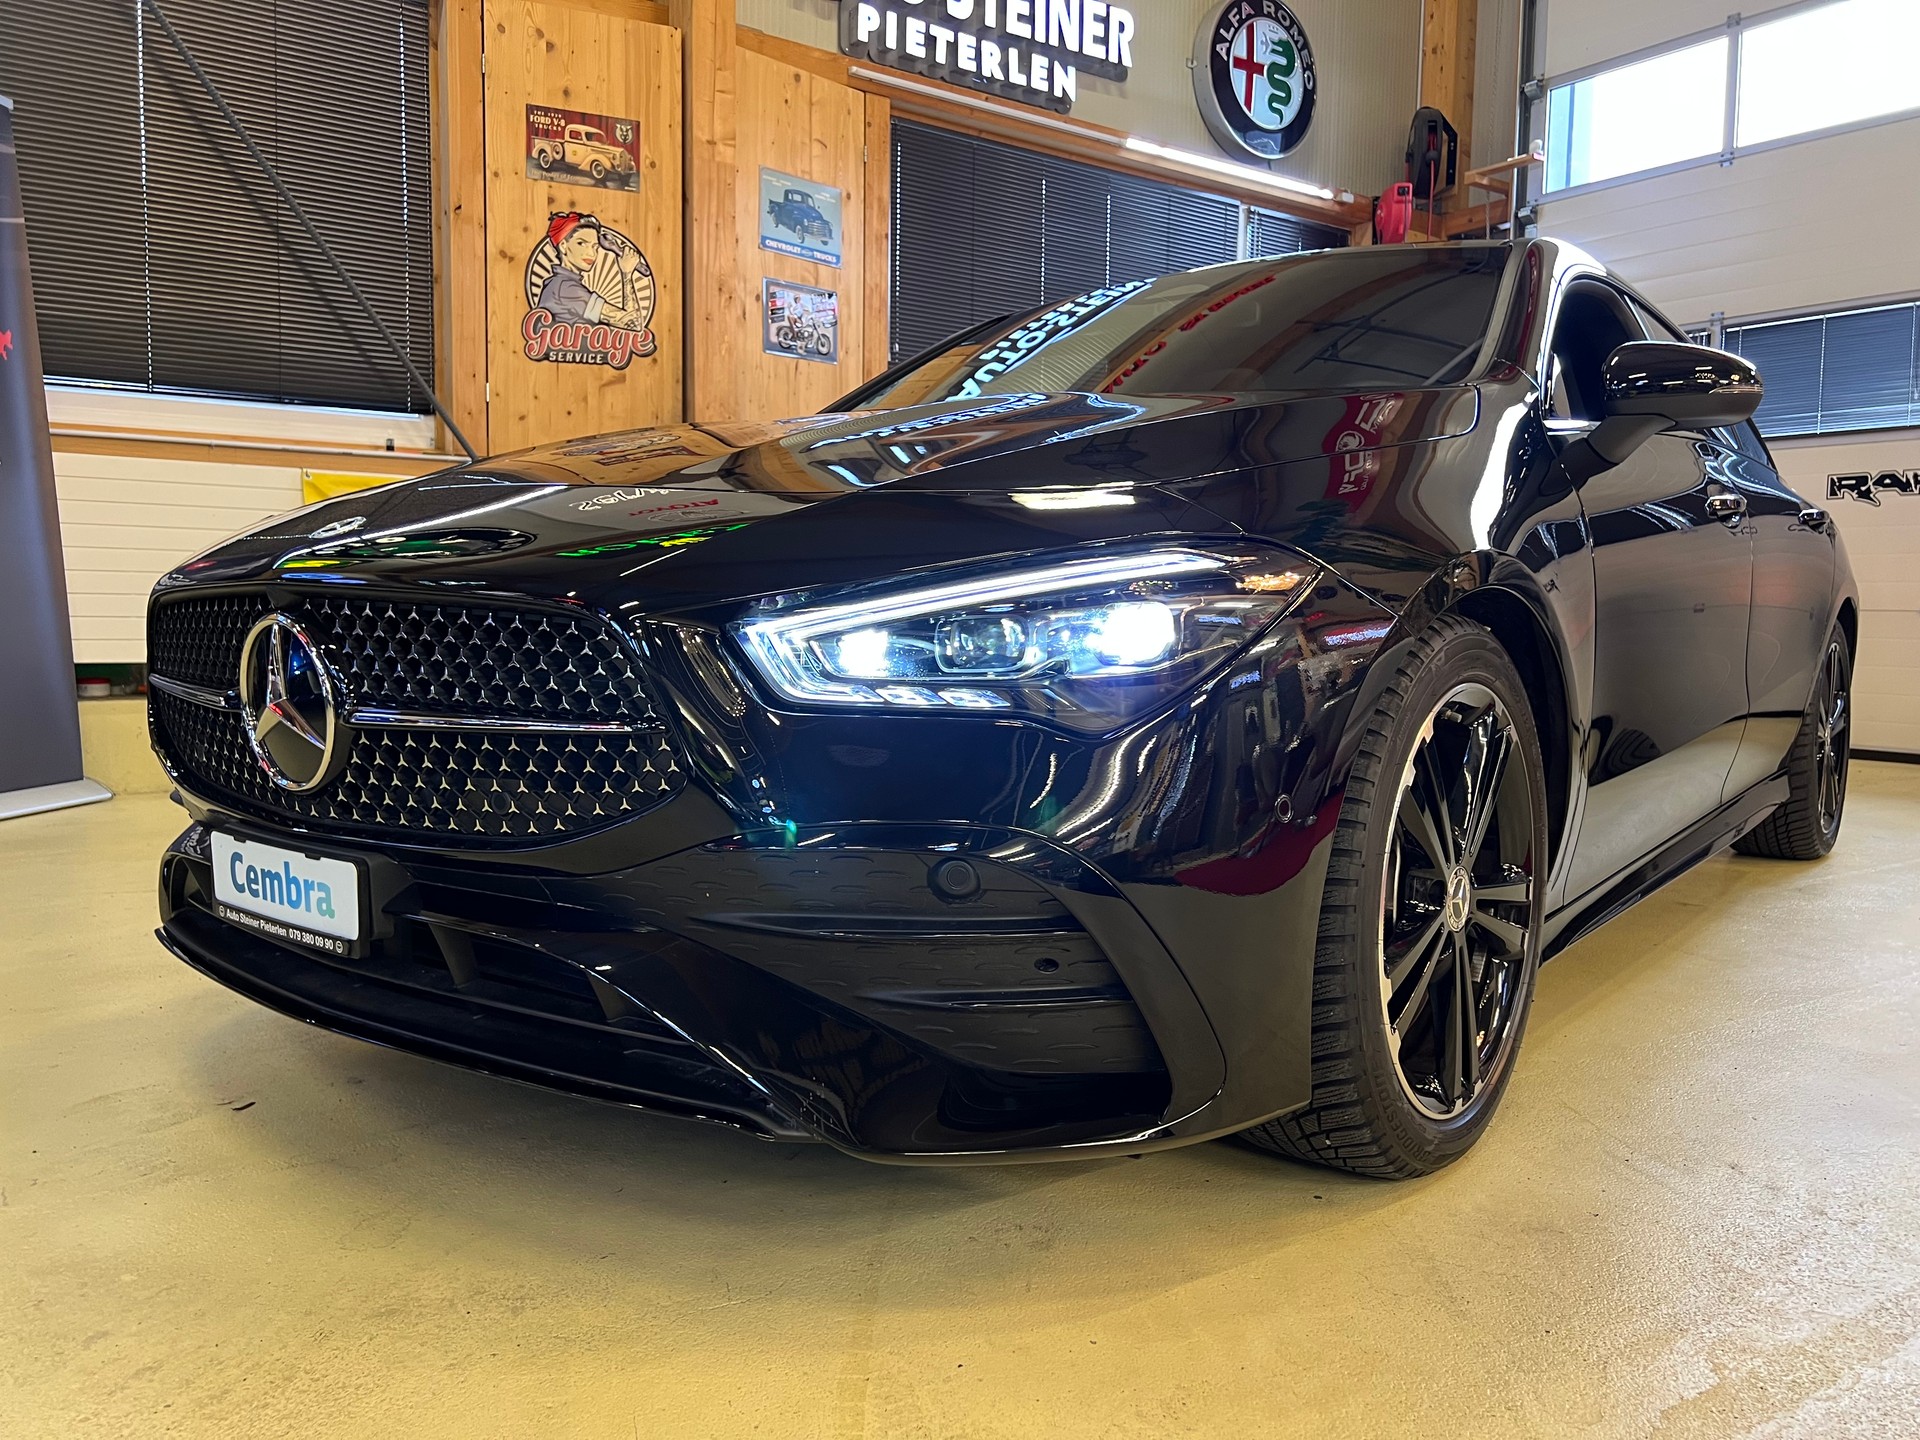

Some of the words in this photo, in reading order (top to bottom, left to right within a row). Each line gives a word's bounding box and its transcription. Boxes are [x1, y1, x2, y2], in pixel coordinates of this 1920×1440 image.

[857, 2, 1077, 102] PIETERLEN
[1216, 1, 1255, 61] ALFA
[1262, 0, 1314, 90] ROMEO
[530, 114, 551, 124] FORD
[553, 118, 565, 126] V-8
[535, 123, 562, 131] TRUCKS
[765, 239, 802, 254] CHEVROLET
[813, 250, 837, 263] TRUCKS
[523, 308, 654, 367] Garage
[549, 351, 604, 364] SERVICE
[1826, 468, 1920, 507] RA
[230, 851, 335, 919] Cembra
[226, 908, 240, 922] Auto
[240, 913, 260, 928] Steiner
[260, 920, 287, 936] Pieterlen
[288, 927, 301, 941] 079
[302, 932, 315, 945] 380
[315, 936, 324, 948] 09
[324, 939, 334, 950] 90
